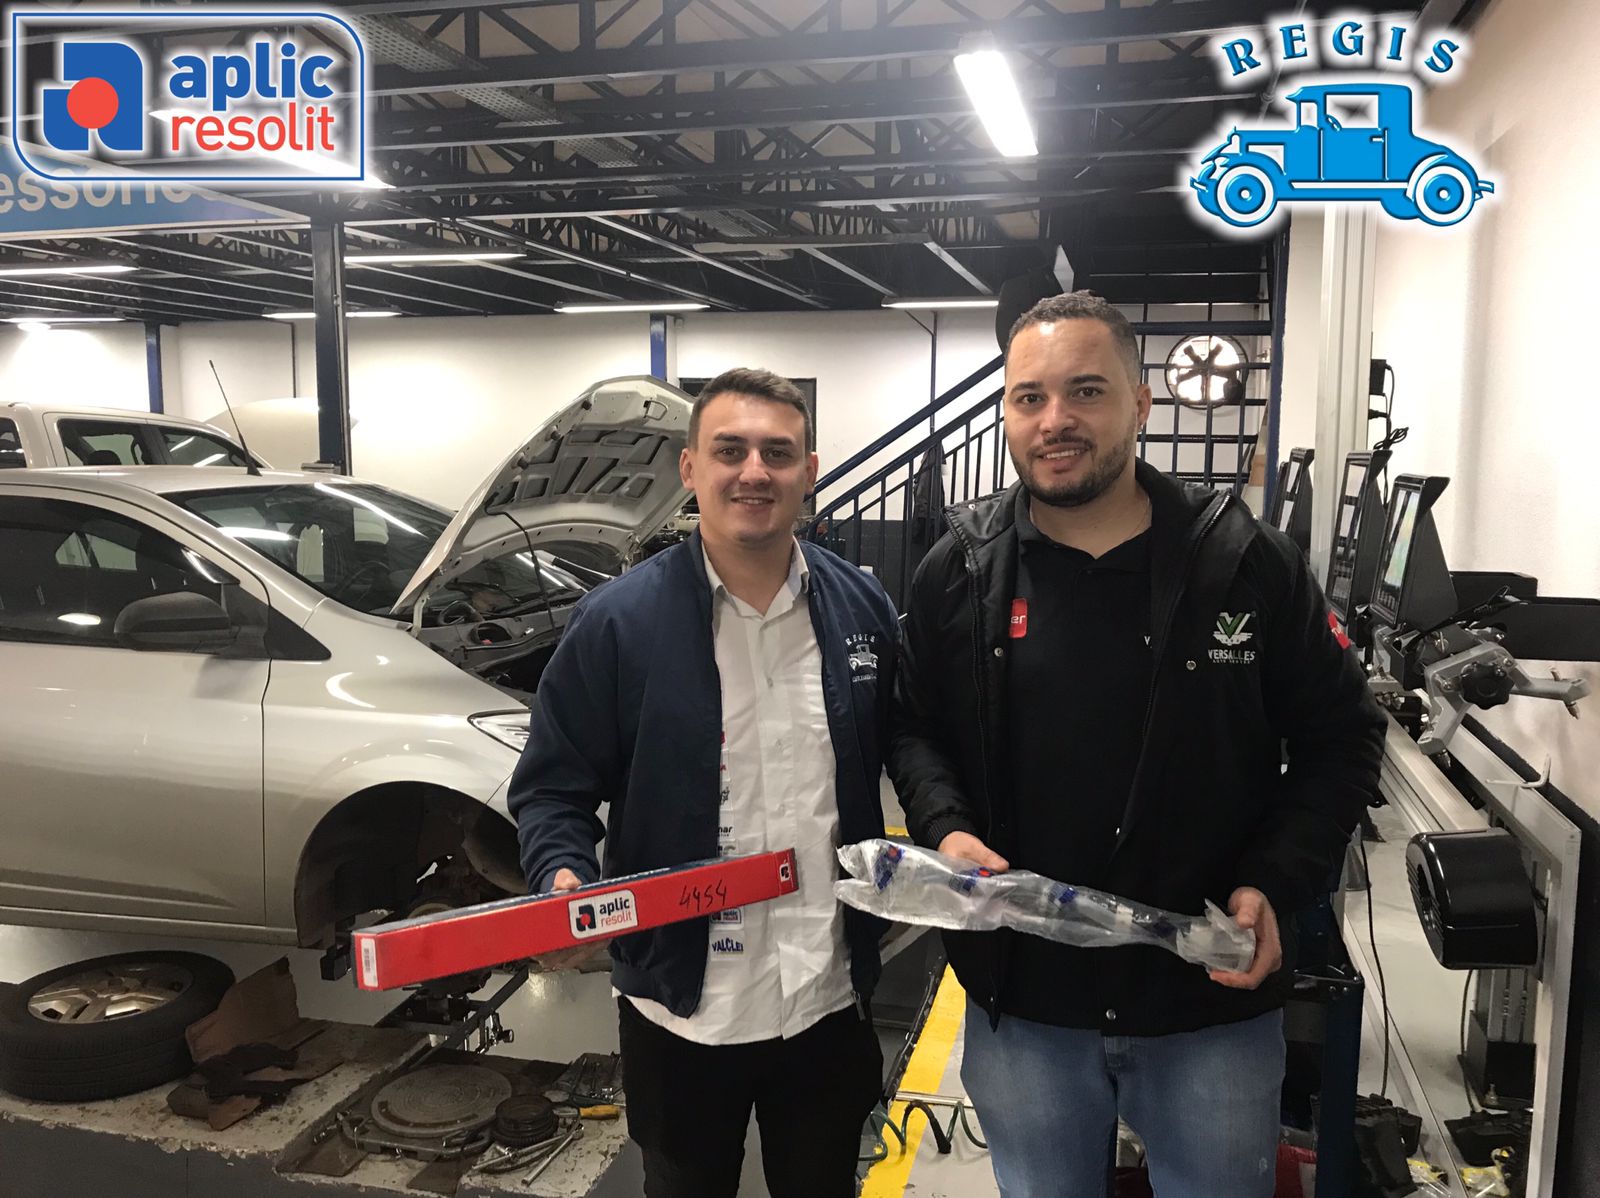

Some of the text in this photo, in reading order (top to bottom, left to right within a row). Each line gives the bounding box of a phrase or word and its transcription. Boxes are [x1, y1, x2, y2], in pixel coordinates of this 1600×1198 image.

[1207, 649, 1256, 661] VERSALLES
[599, 897, 630, 916] aplic
[600, 910, 632, 927] resolit
